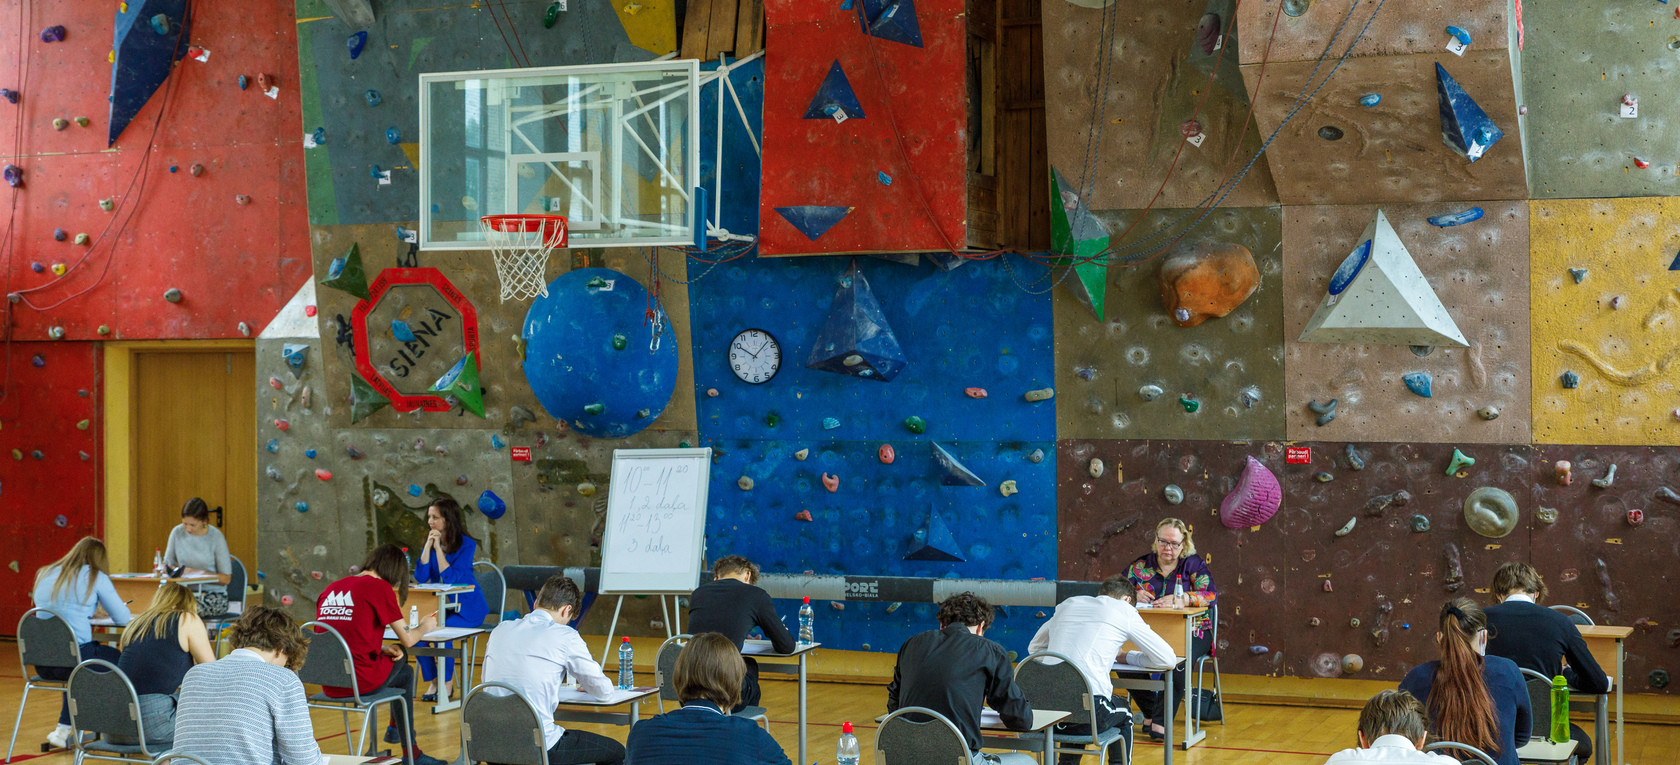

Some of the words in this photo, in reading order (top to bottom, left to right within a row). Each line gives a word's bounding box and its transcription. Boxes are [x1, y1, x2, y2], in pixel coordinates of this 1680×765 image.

[1629, 106, 1635, 115] 2
[441, 282, 462, 304] CENTRS
[467, 326, 477, 351] SPORTA
[750, 330, 758, 338] 12
[733, 342, 742, 350] 10
[770, 341, 776, 349] 2
[773, 352, 779, 360] 3
[627, 538, 638, 552] 3
[320, 606, 353, 616] Toode
